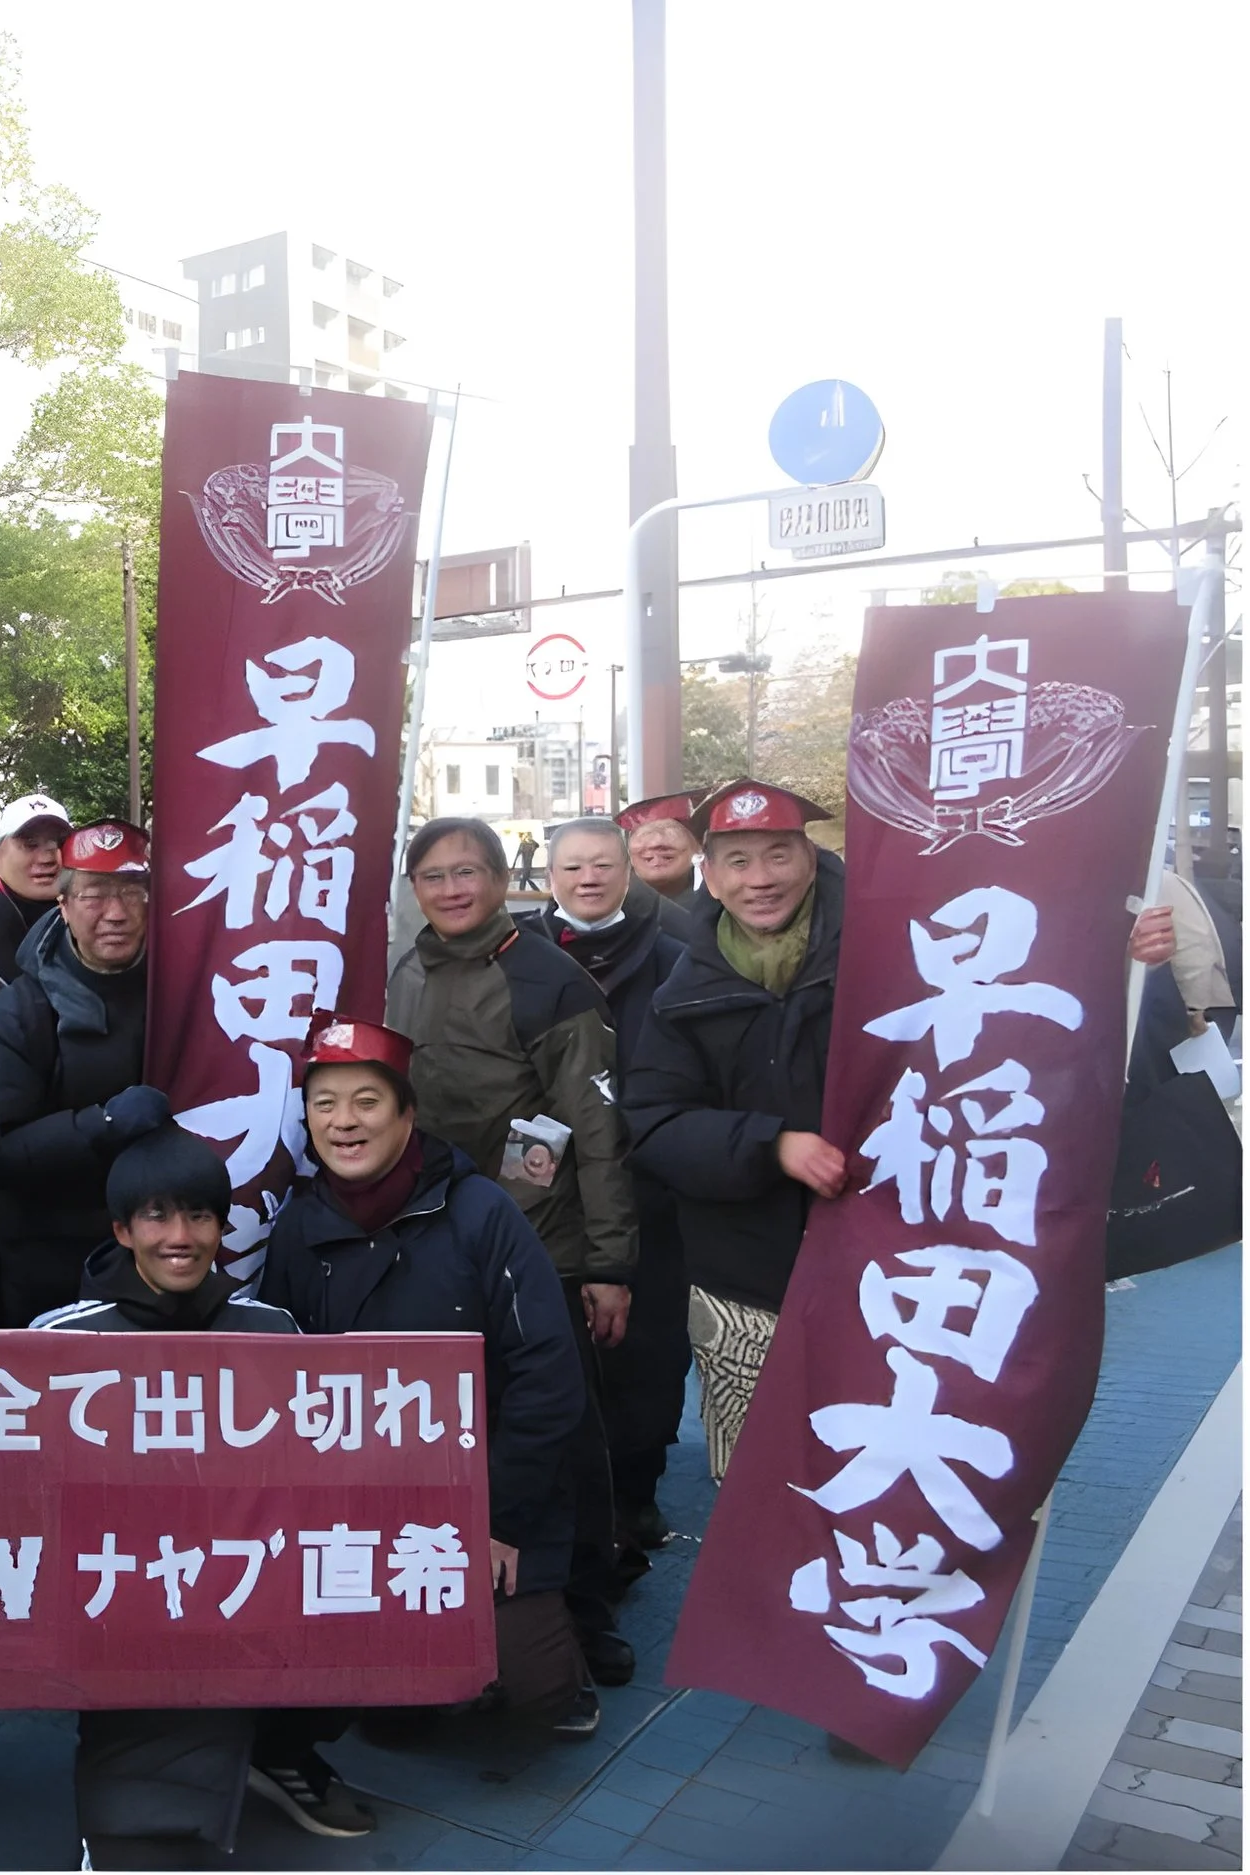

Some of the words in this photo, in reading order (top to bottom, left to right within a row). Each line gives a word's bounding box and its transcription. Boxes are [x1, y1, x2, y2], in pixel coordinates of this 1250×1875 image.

[786, 885, 1084, 1700] 早稲田大学
